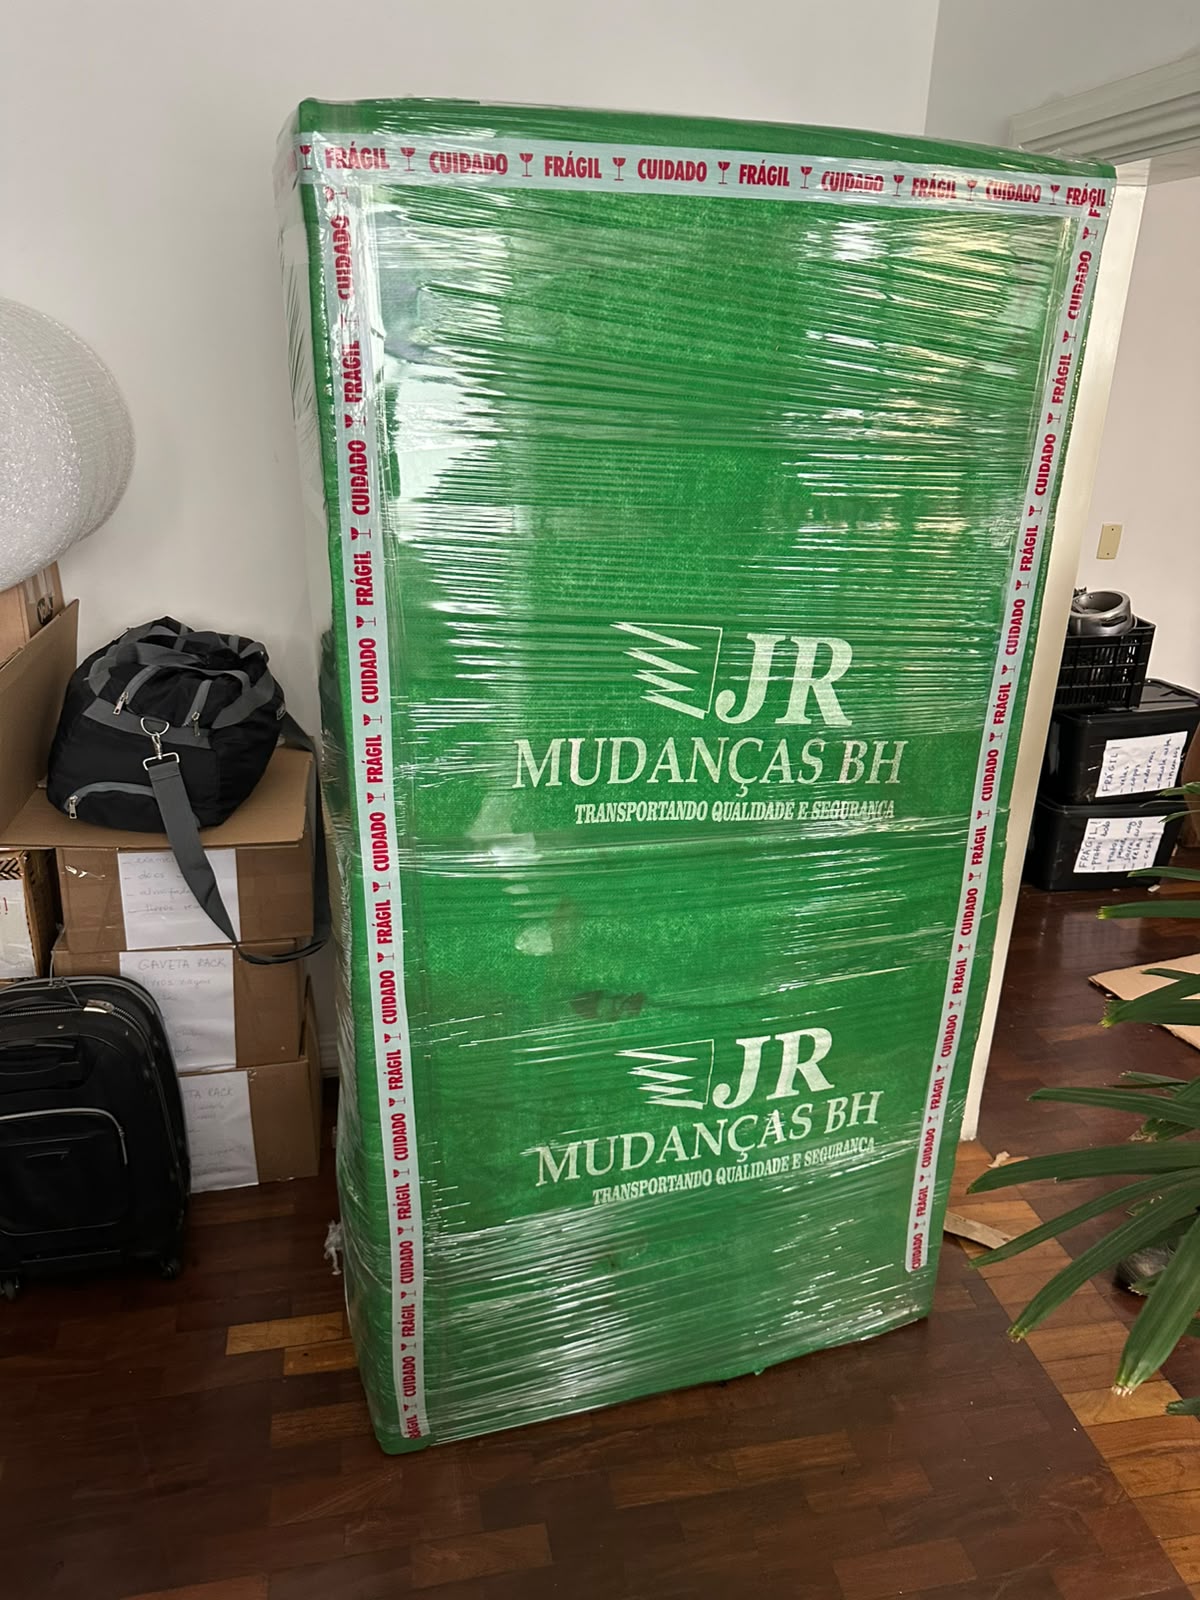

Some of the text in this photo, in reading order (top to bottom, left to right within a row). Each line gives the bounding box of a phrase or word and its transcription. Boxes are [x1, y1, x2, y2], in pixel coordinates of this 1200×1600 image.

[325, 141, 1107, 207] FRÁGIL CUIDADO FRÁGIL CUIDADO FRÁGIL CUIDADO FRÁGIL CUIDADO FRÁGIL
[330, 215, 352, 300] CUIDADO
[341, 341, 363, 404] FRÁGIL
[347, 439, 371, 516] CUIDADO
[348, 551, 374, 607] FRÁGIL
[357, 637, 379, 705] CUIDADO
[715, 633, 853, 726] JR
[360, 734, 383, 784] FRÁGIL
[511, 736, 909, 797] MUDANÇAS BH
[911, 250, 1092, 1270] CUIDADO FRÁGIL CUIDADO FRÁGIL CUIDADO FRÁGIL CUIDADO FRÁGIL CUIDADO FRÁGIL CUIDADO FRÁGIL CUIDADO FRÁGIL CUIDADO
[368, 811, 390, 873] CUIDADO
[575, 799, 895, 825] TRANSPORTANDO QUALIDADE E SEGURANÇA
[369, 899, 393, 945] FRÁGIL
[378, 969, 398, 1025] CUIDADO
[381, 1049, 403, 1091] FRÁGIL
[713, 1027, 835, 1110] JR
[390, 1113, 409, 1162] CUIDADO
[534, 1091, 885, 1187] MUDANÇAS BH
[592, 1135, 876, 1206] TRANSPORTANDO QUALIDADE E SEGURANÇA
[390, 1183, 411, 1221] FRÁGIL
[399, 1240, 414, 1285] CUIDADO
[396, 1304, 415, 1337] FRÁGIL
[402, 1356, 415, 1397] CUIDADO
